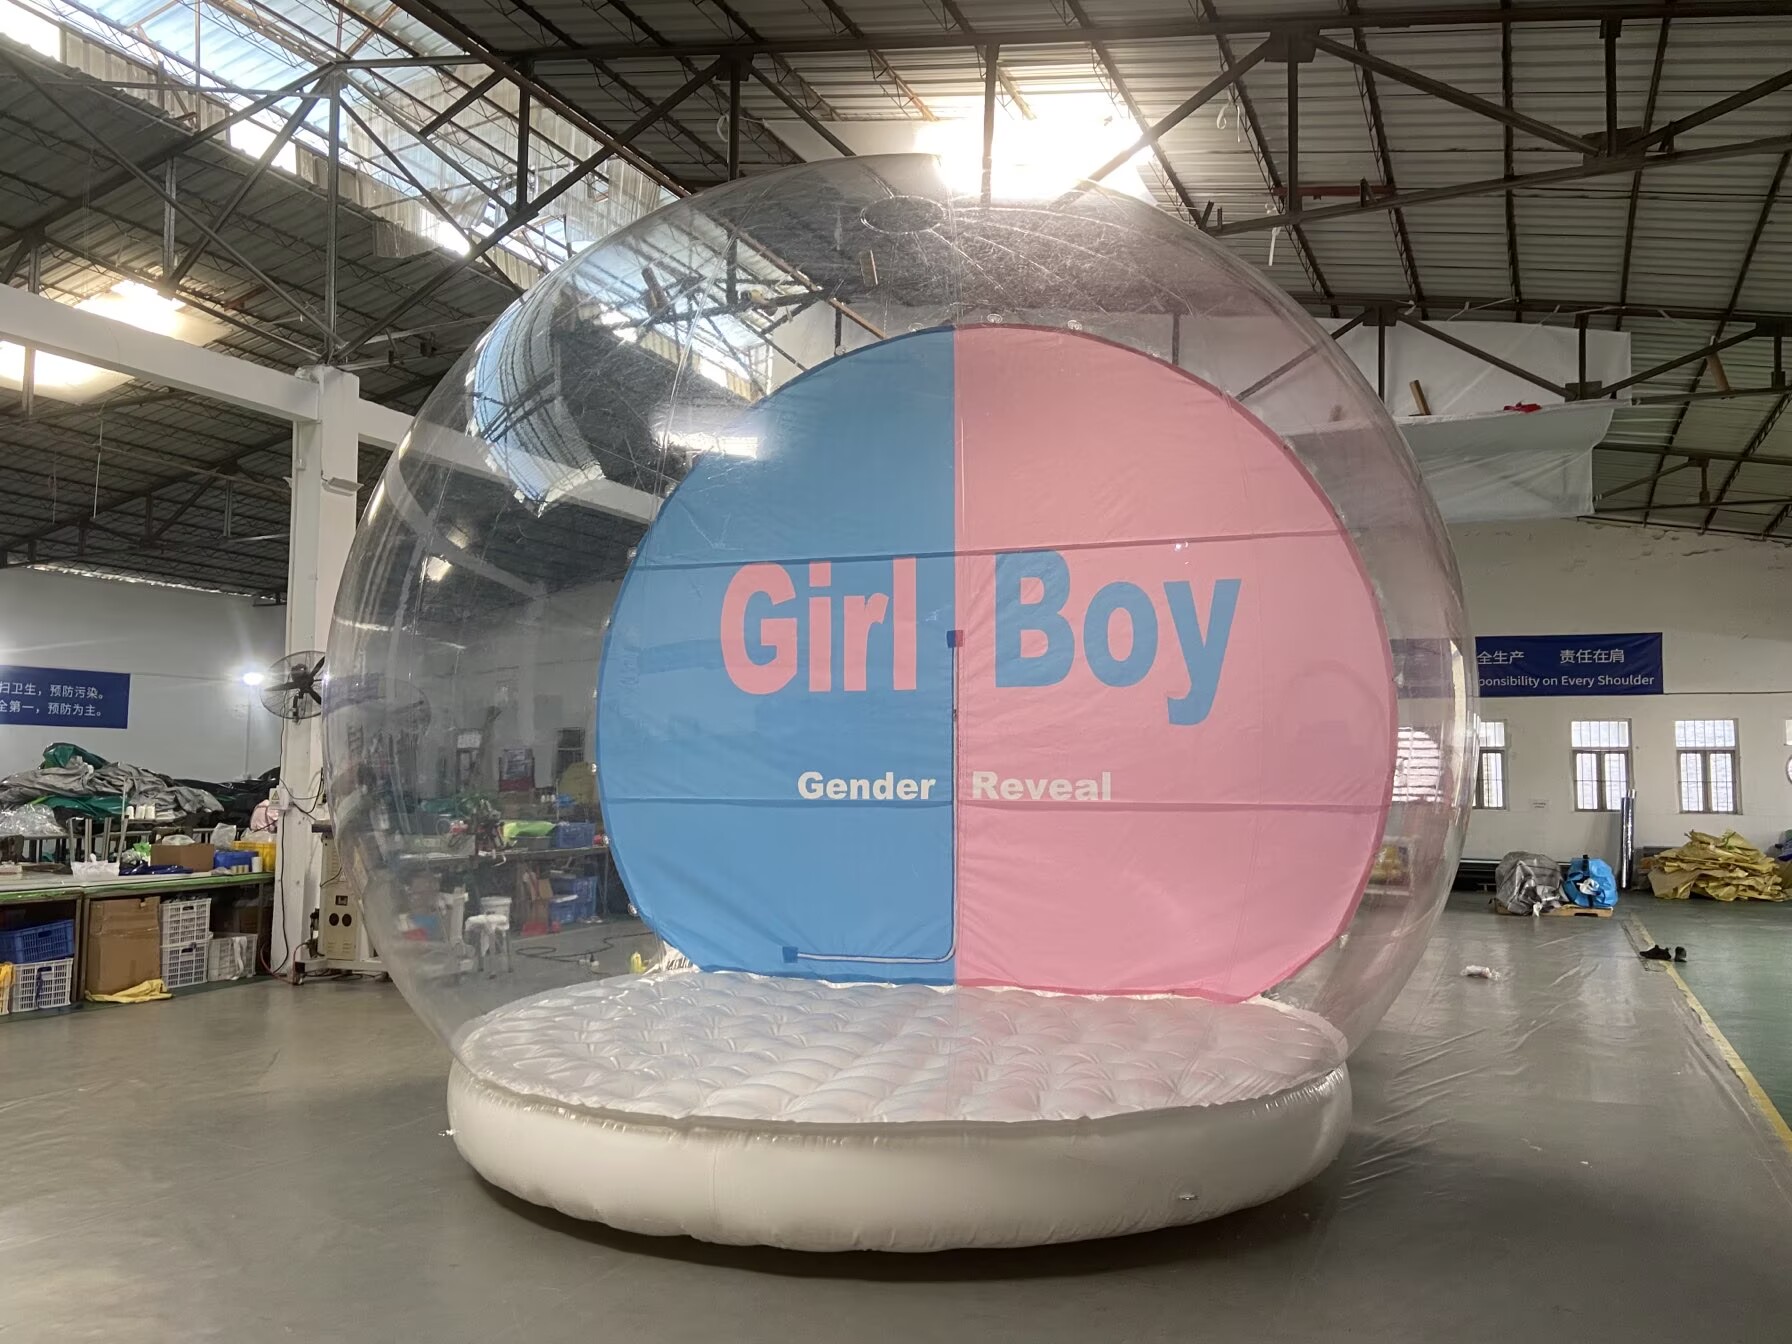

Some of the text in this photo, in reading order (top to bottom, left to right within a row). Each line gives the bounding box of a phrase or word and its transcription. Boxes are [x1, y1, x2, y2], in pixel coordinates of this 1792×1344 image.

[721, 550, 1242, 726] Girl Boy
[1477, 648, 1625, 665] 全生产 责任在肩
[1542, 678, 1558, 686] on
[1561, 675, 1595, 688] Every
[1597, 674, 1655, 686] Shoulder
[798, 771, 1112, 801] Gender Reveal
